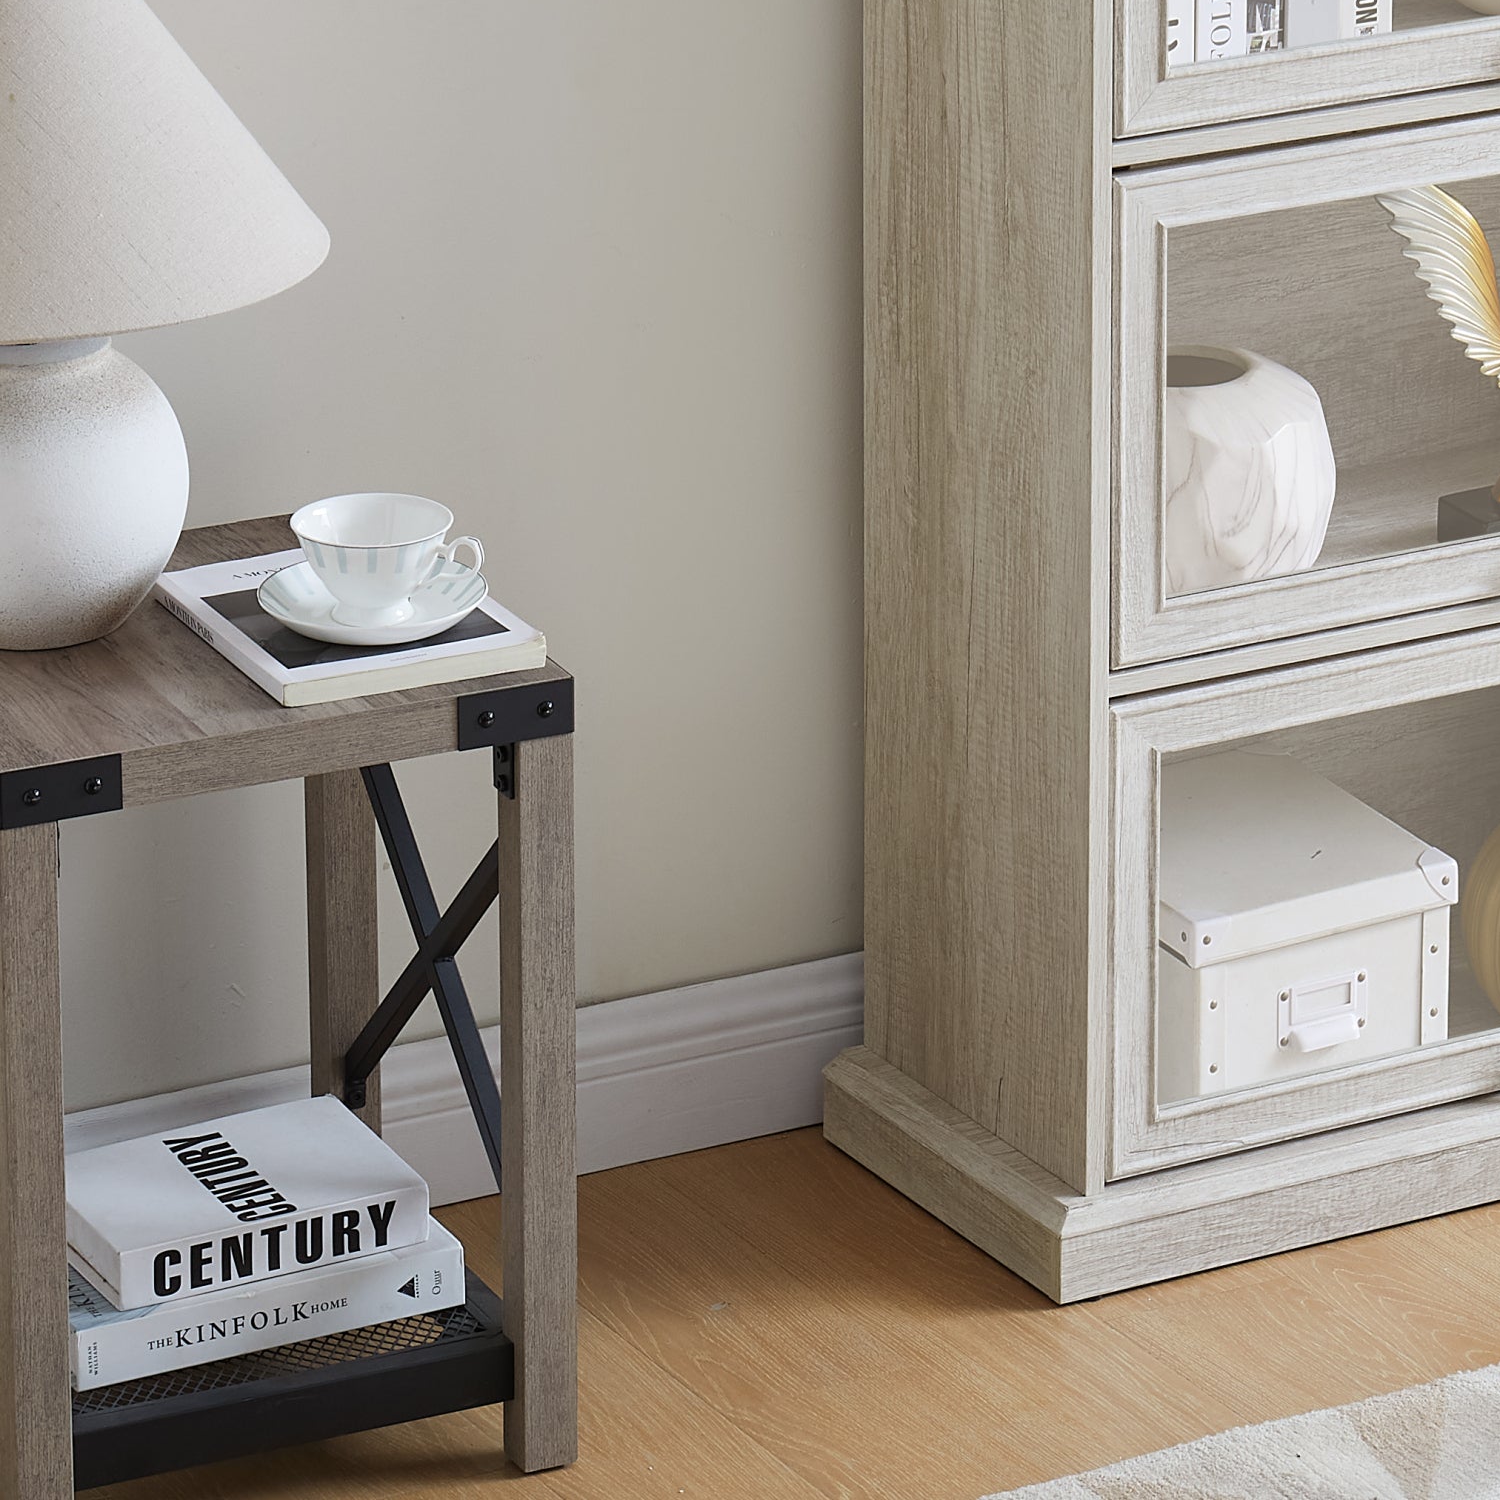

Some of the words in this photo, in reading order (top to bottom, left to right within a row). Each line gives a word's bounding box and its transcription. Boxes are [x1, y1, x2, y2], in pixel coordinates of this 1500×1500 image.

[162, 1131, 298, 1223] CENTURY
[153, 1200, 397, 1298] CENTURY
[147, 1337, 173, 1350] THE
[175, 1301, 310, 1348] KINFOLK
[311, 1297, 349, 1315] HOME
